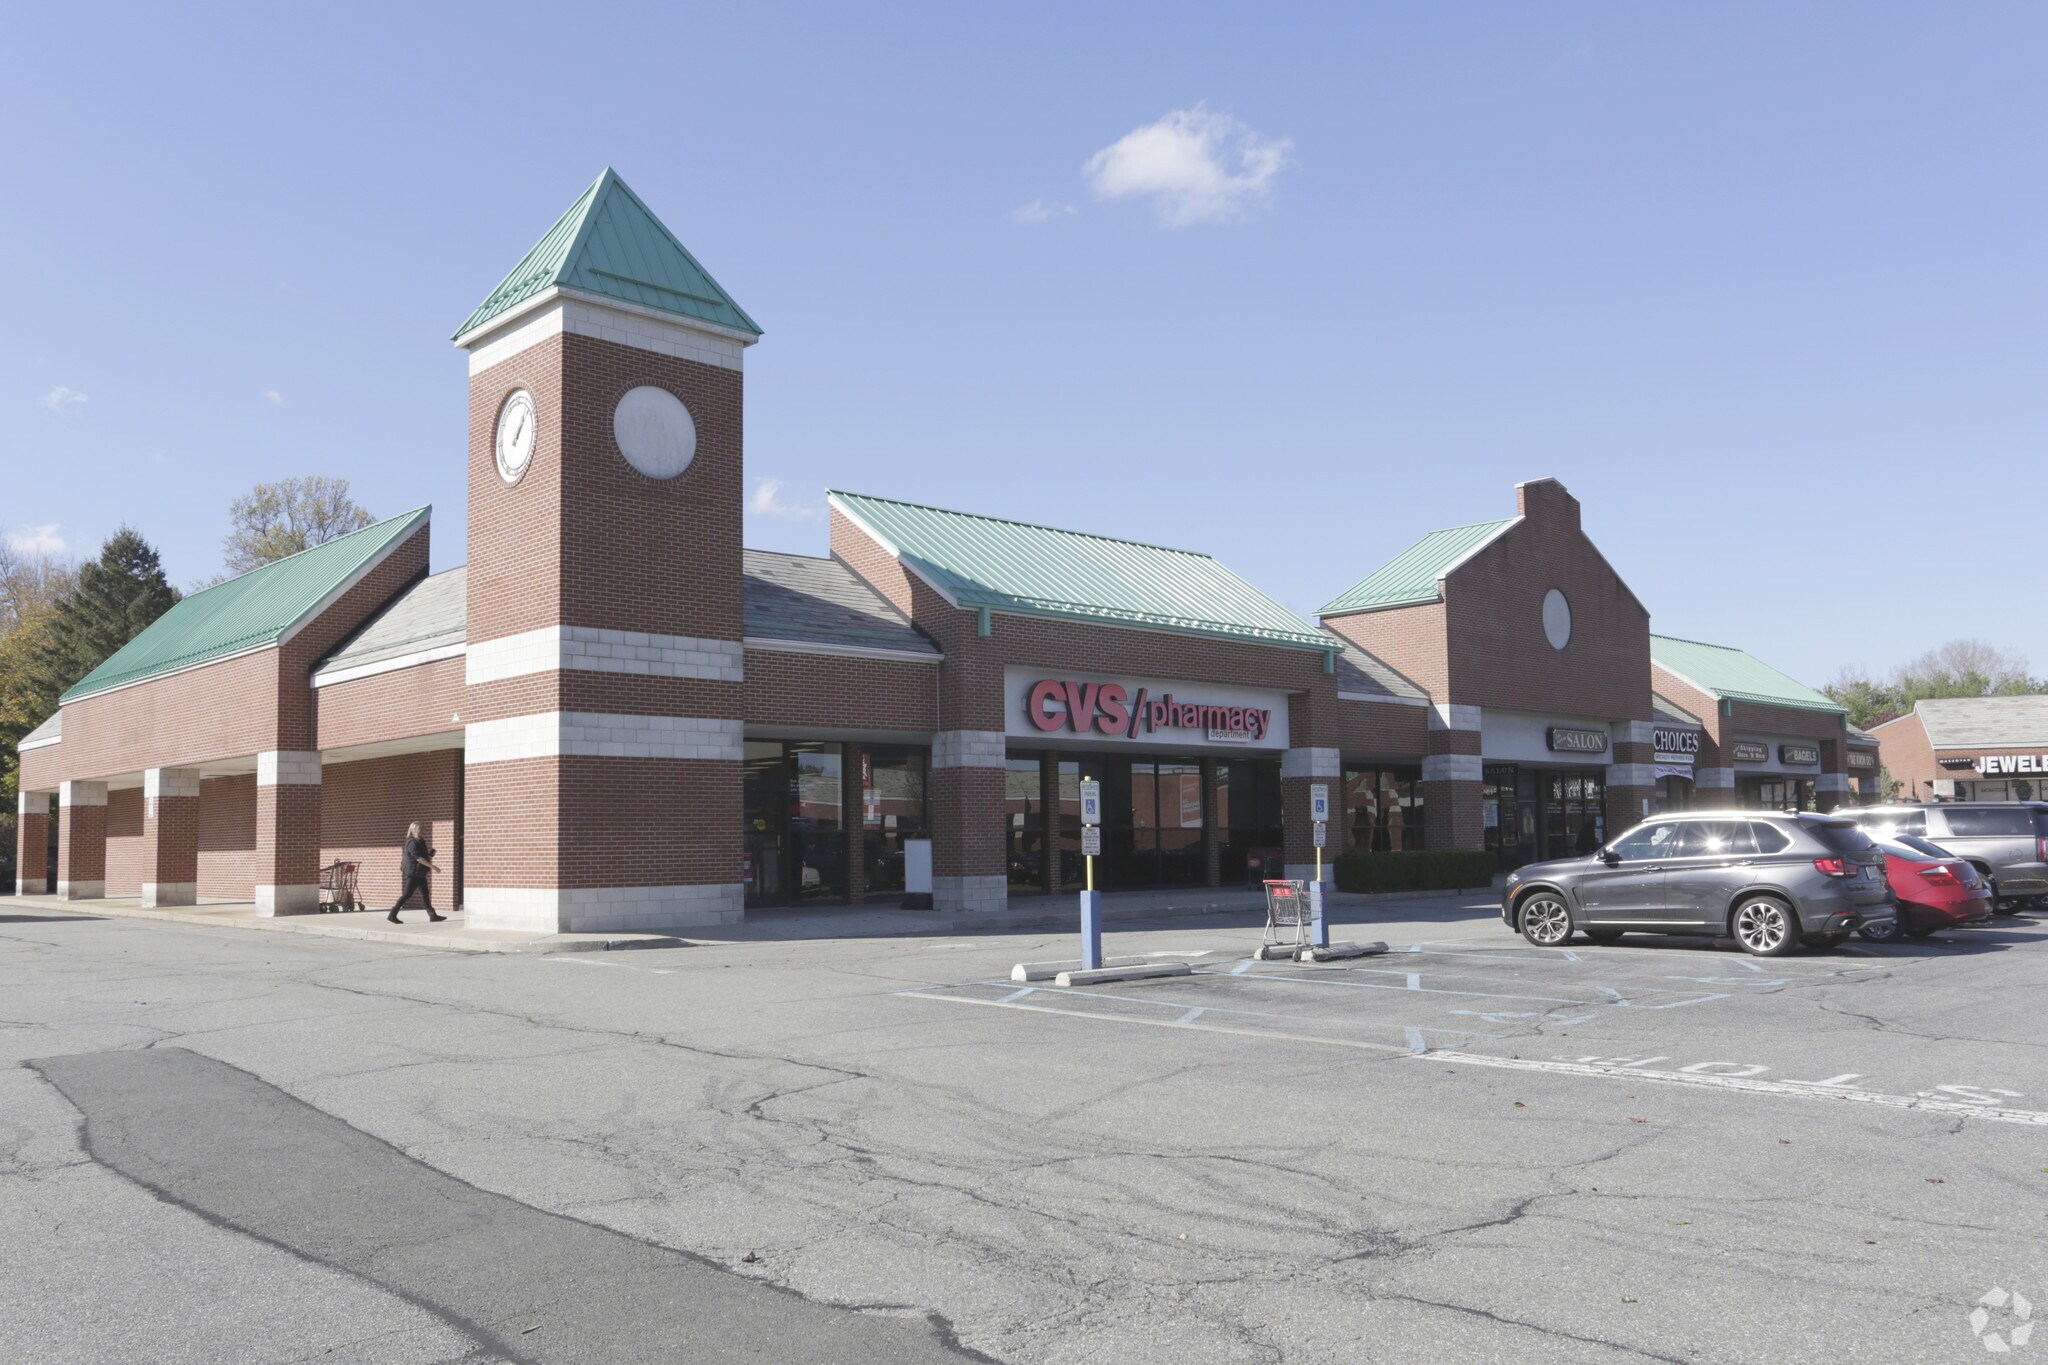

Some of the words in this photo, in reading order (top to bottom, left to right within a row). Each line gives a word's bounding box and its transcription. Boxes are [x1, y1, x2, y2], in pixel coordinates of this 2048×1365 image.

[1211, 730, 1249, 739] department
[1567, 733, 1602, 749] SALON
[1653, 730, 1699, 752] CHOICES
[1794, 750, 1817, 762] BAGELS
